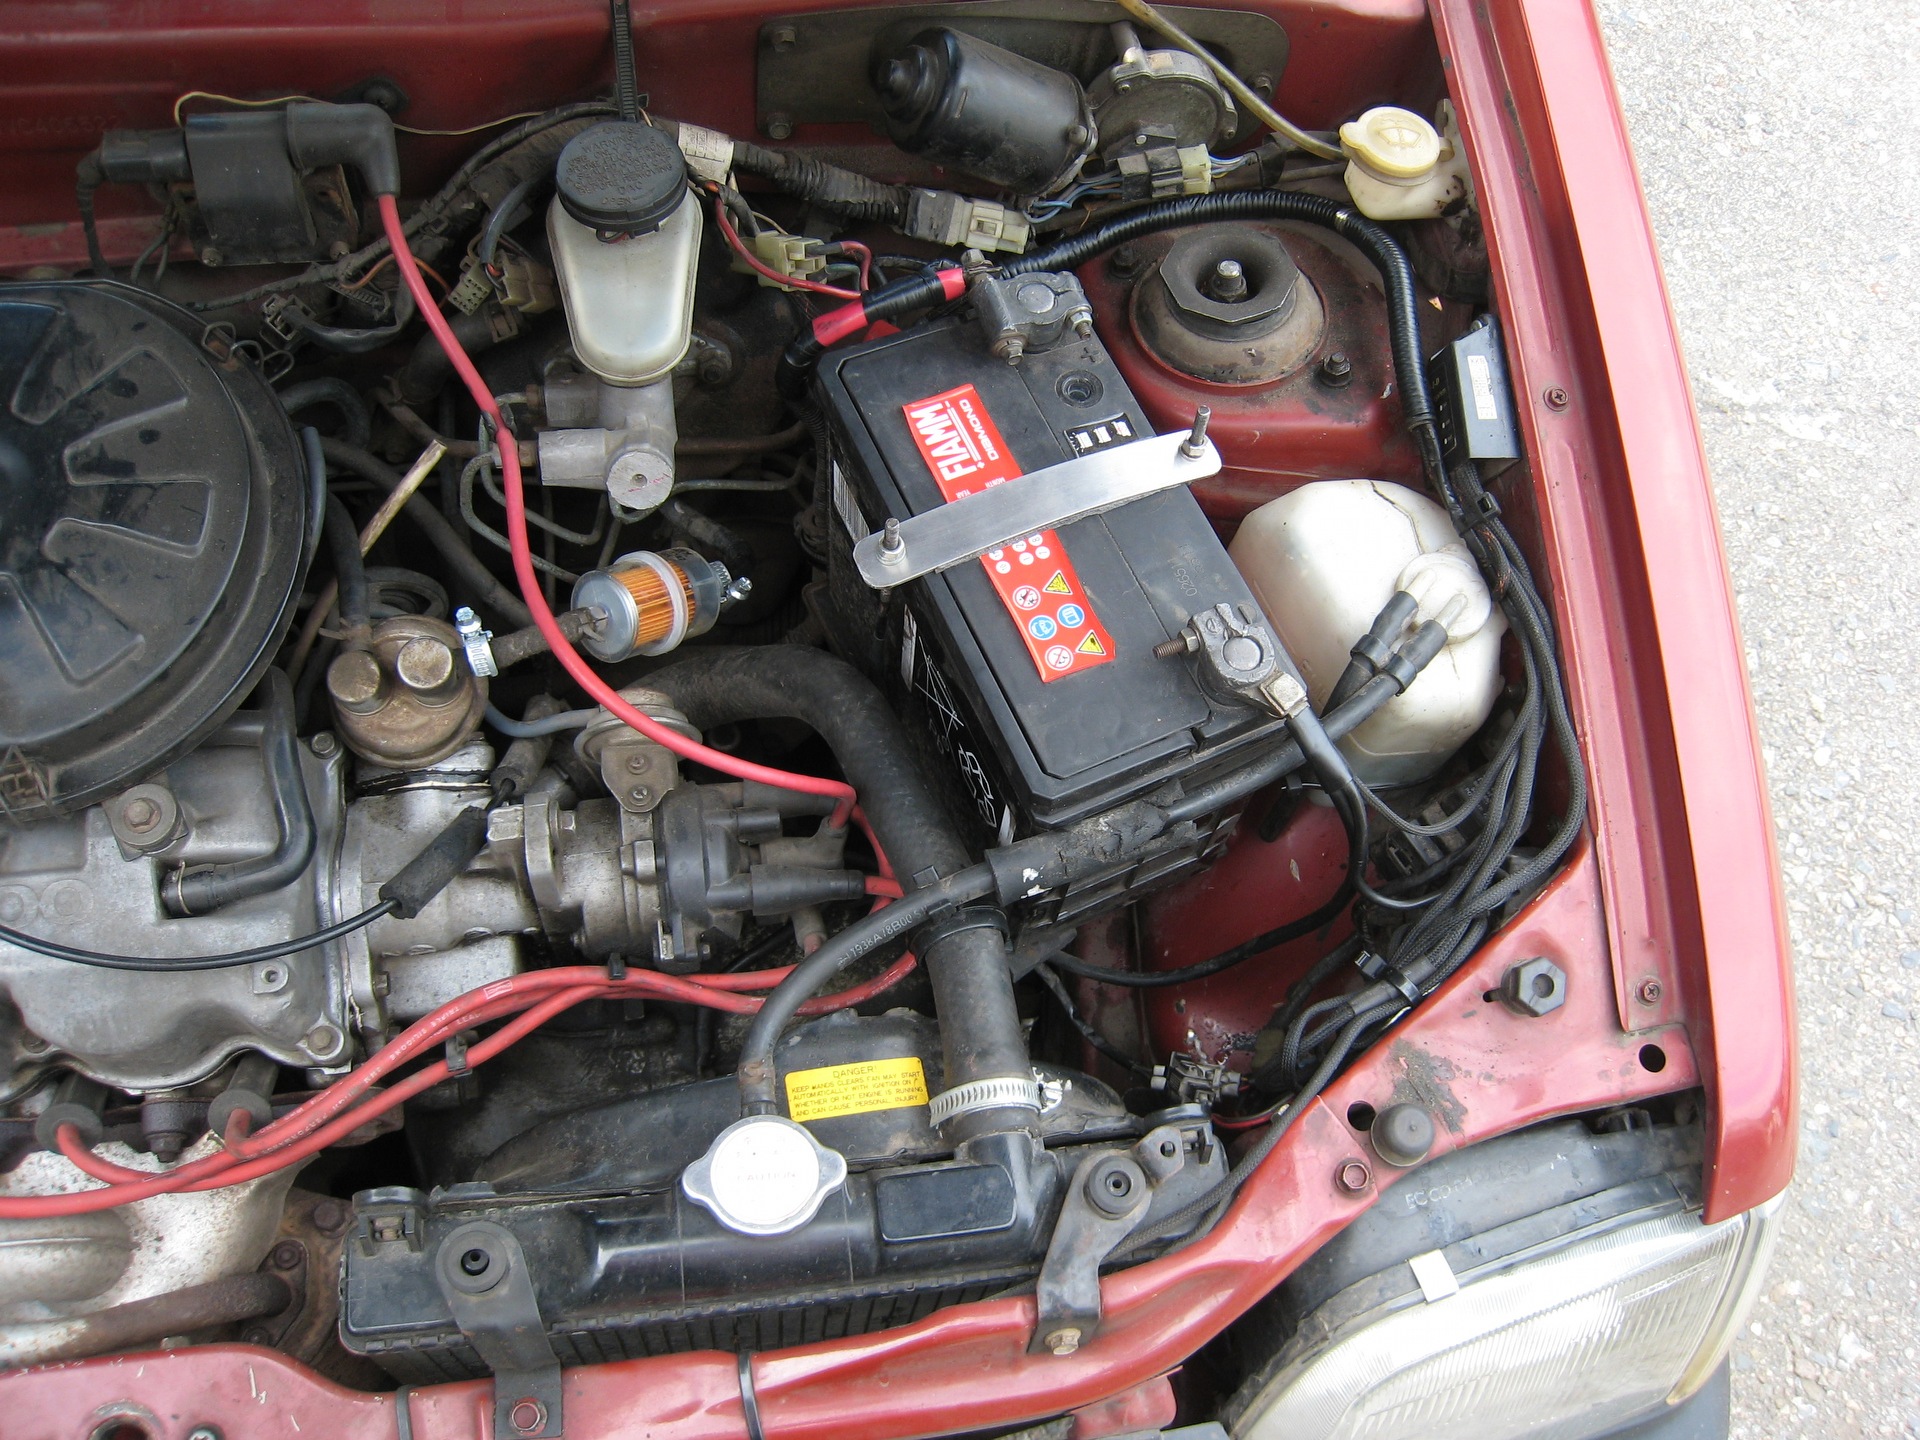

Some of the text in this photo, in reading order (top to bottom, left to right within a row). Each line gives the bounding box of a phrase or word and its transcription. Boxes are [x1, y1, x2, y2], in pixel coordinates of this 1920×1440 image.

[581, 134, 635, 154] WARNING
[959, 399, 999, 462] DIAMOND
[910, 403, 977, 481] FIAMM
[791, 1085, 810, 1093] KEEP
[882, 1073, 897, 1081] MAY
[901, 1071, 921, 1079] START
[792, 1088, 849, 1101] AUTOMATICALLY
[872, 1080, 900, 1089] IGNITION
[794, 1099, 828, 1109] WHETHER
[858, 1090, 882, 1099] ENGINE
[895, 1086, 924, 1094] RUNNING
[795, 1095, 918, 1117] AND CAN CAUSE PERSONAL INJURY
